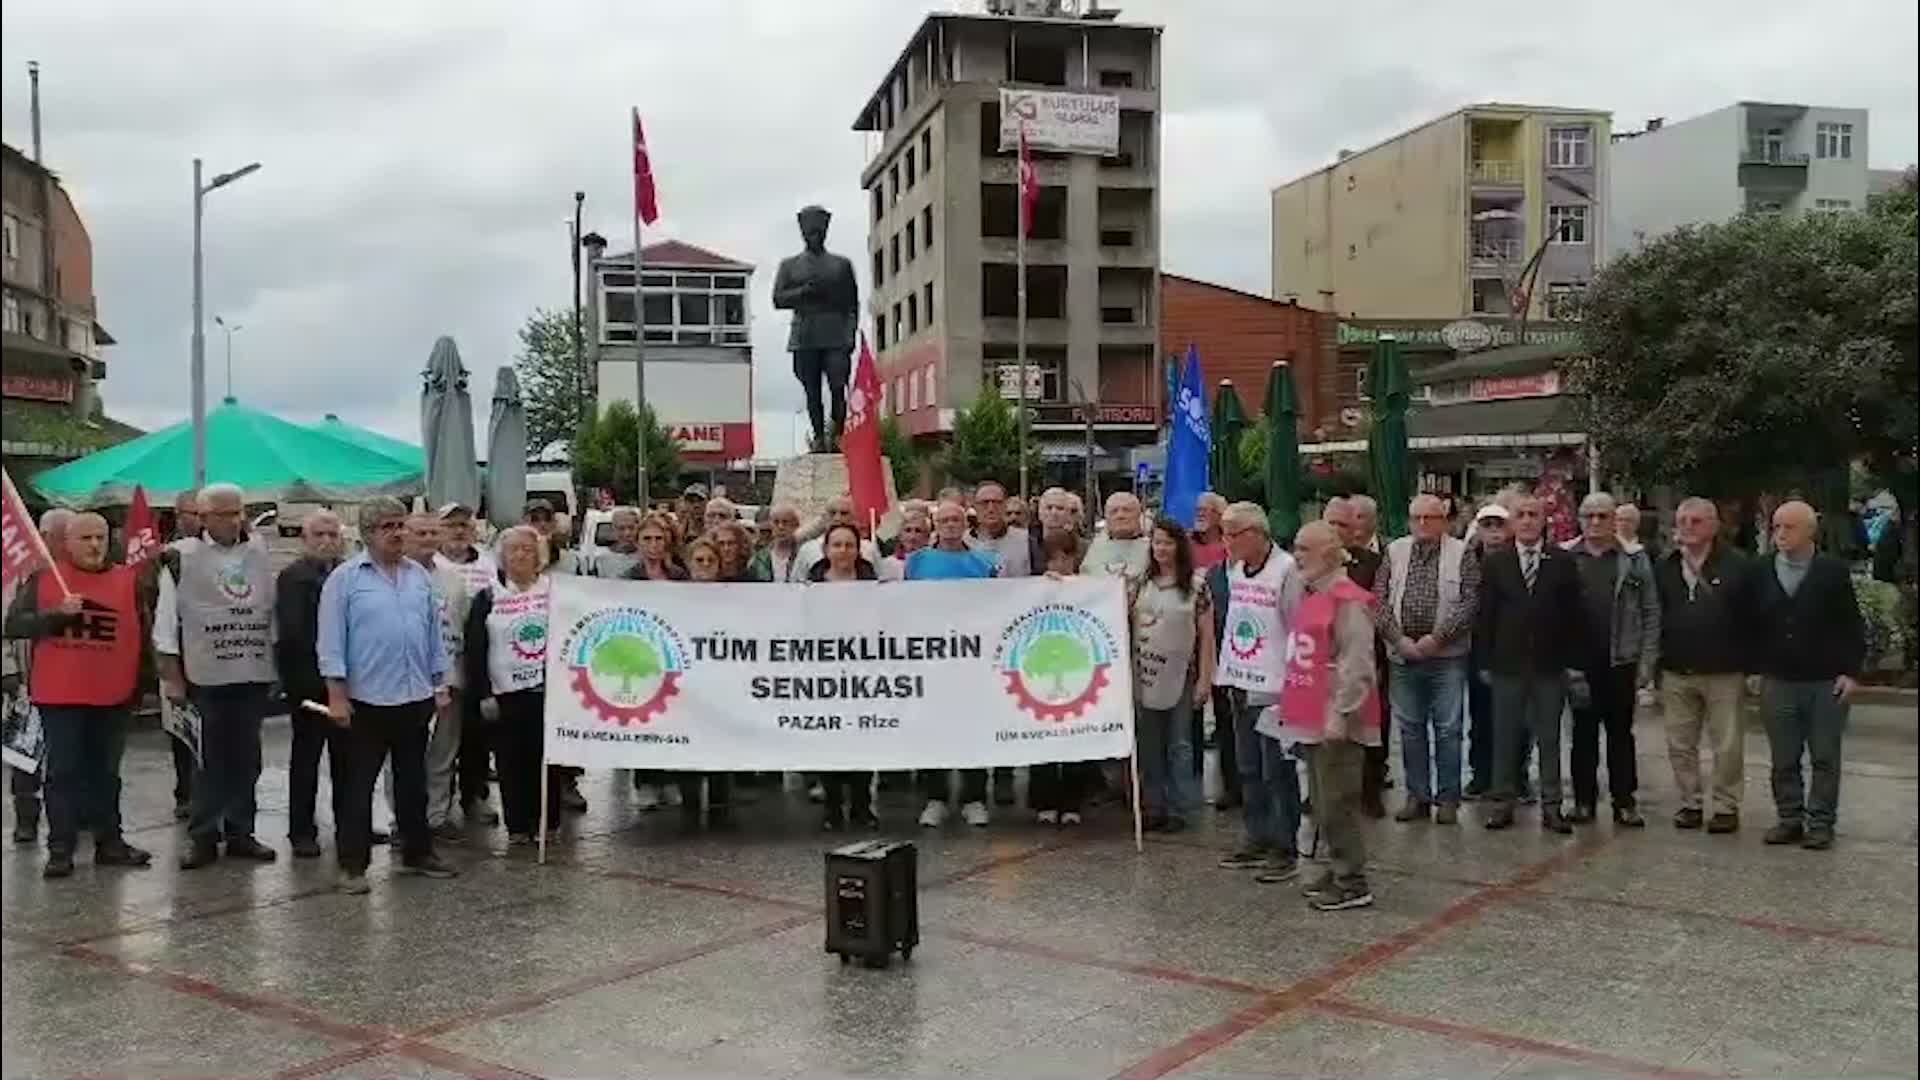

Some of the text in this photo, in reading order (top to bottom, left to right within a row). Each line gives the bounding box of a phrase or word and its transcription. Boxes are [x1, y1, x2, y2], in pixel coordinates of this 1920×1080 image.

[690, 629, 982, 663] TÜM EMEKLİLERİN
[751, 669, 925, 699] SENDİKASI
[777, 714, 842, 731] PAZAR
